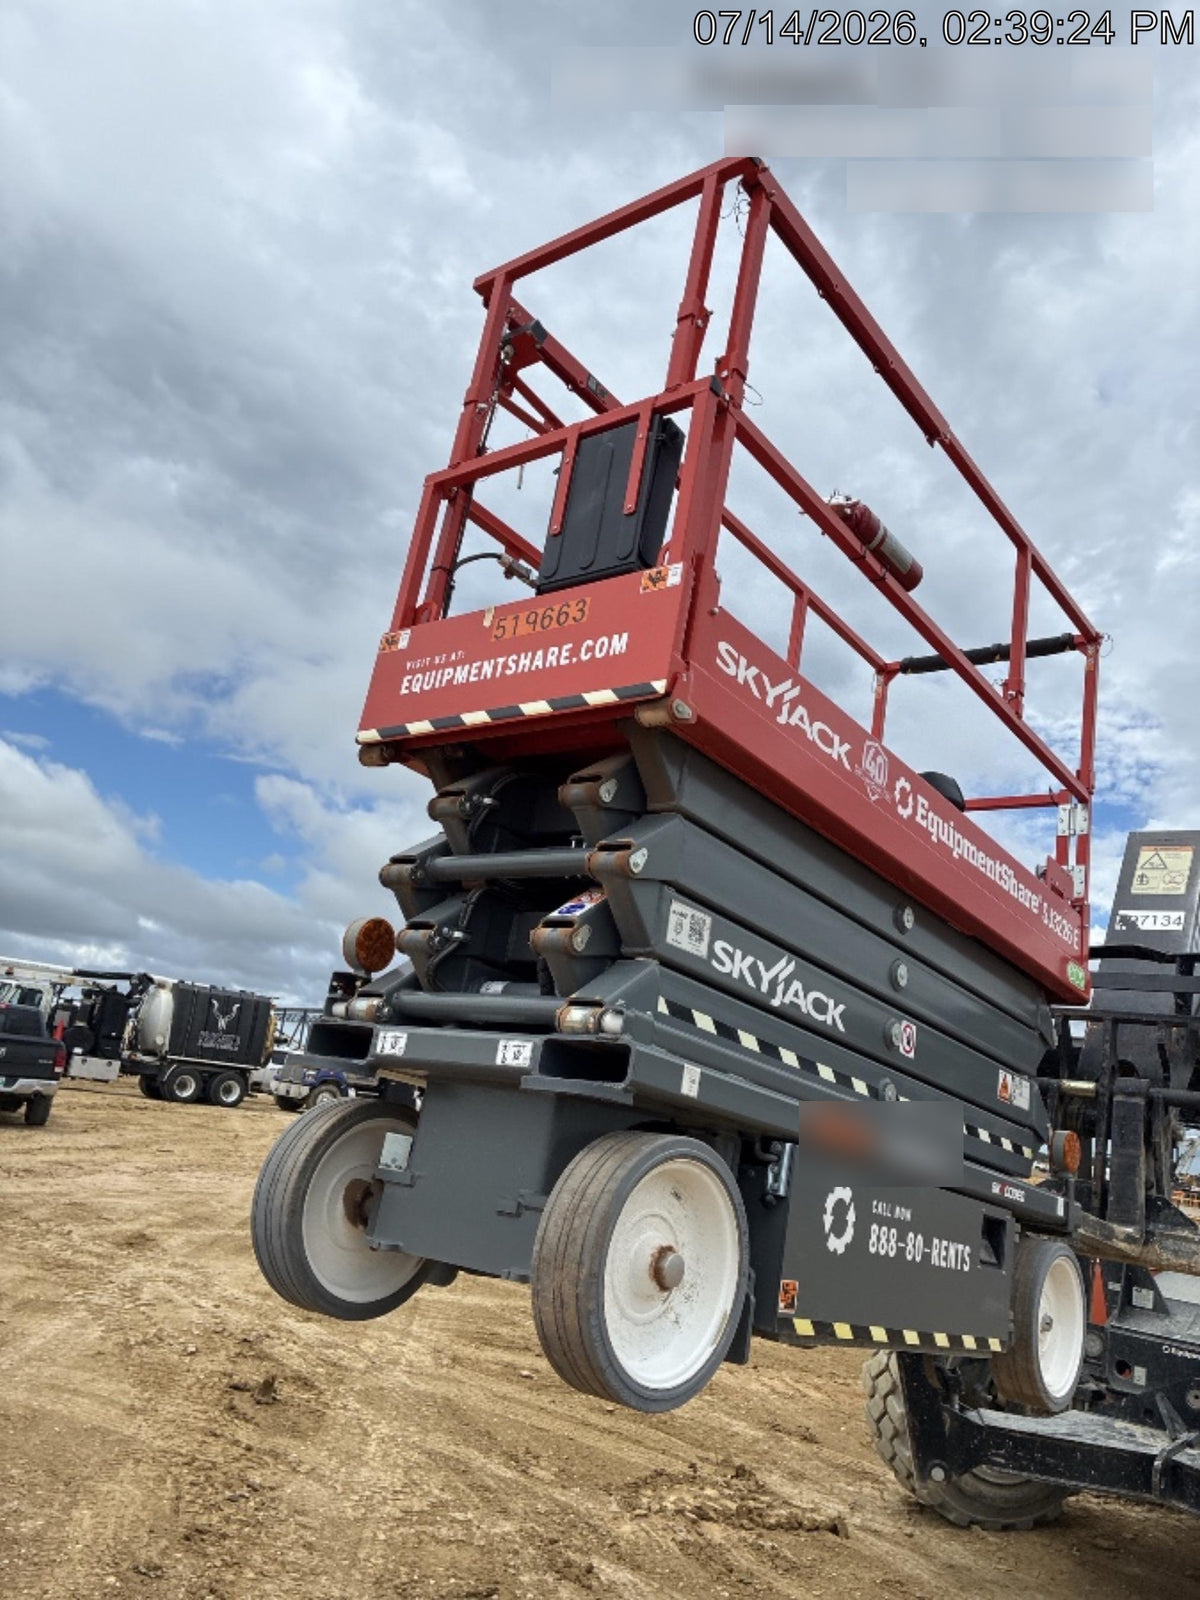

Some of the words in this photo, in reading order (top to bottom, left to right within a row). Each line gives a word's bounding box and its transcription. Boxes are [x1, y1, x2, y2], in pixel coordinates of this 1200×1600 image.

[493, 598, 588, 640] 519663
[399, 632, 629, 696] EQUIPMENTSHARE.COM
[716, 641, 852, 772] SKYJACK
[711, 940, 847, 1033] SKYJACK
[868, 1222, 972, 1272] 888-80-RENTS
